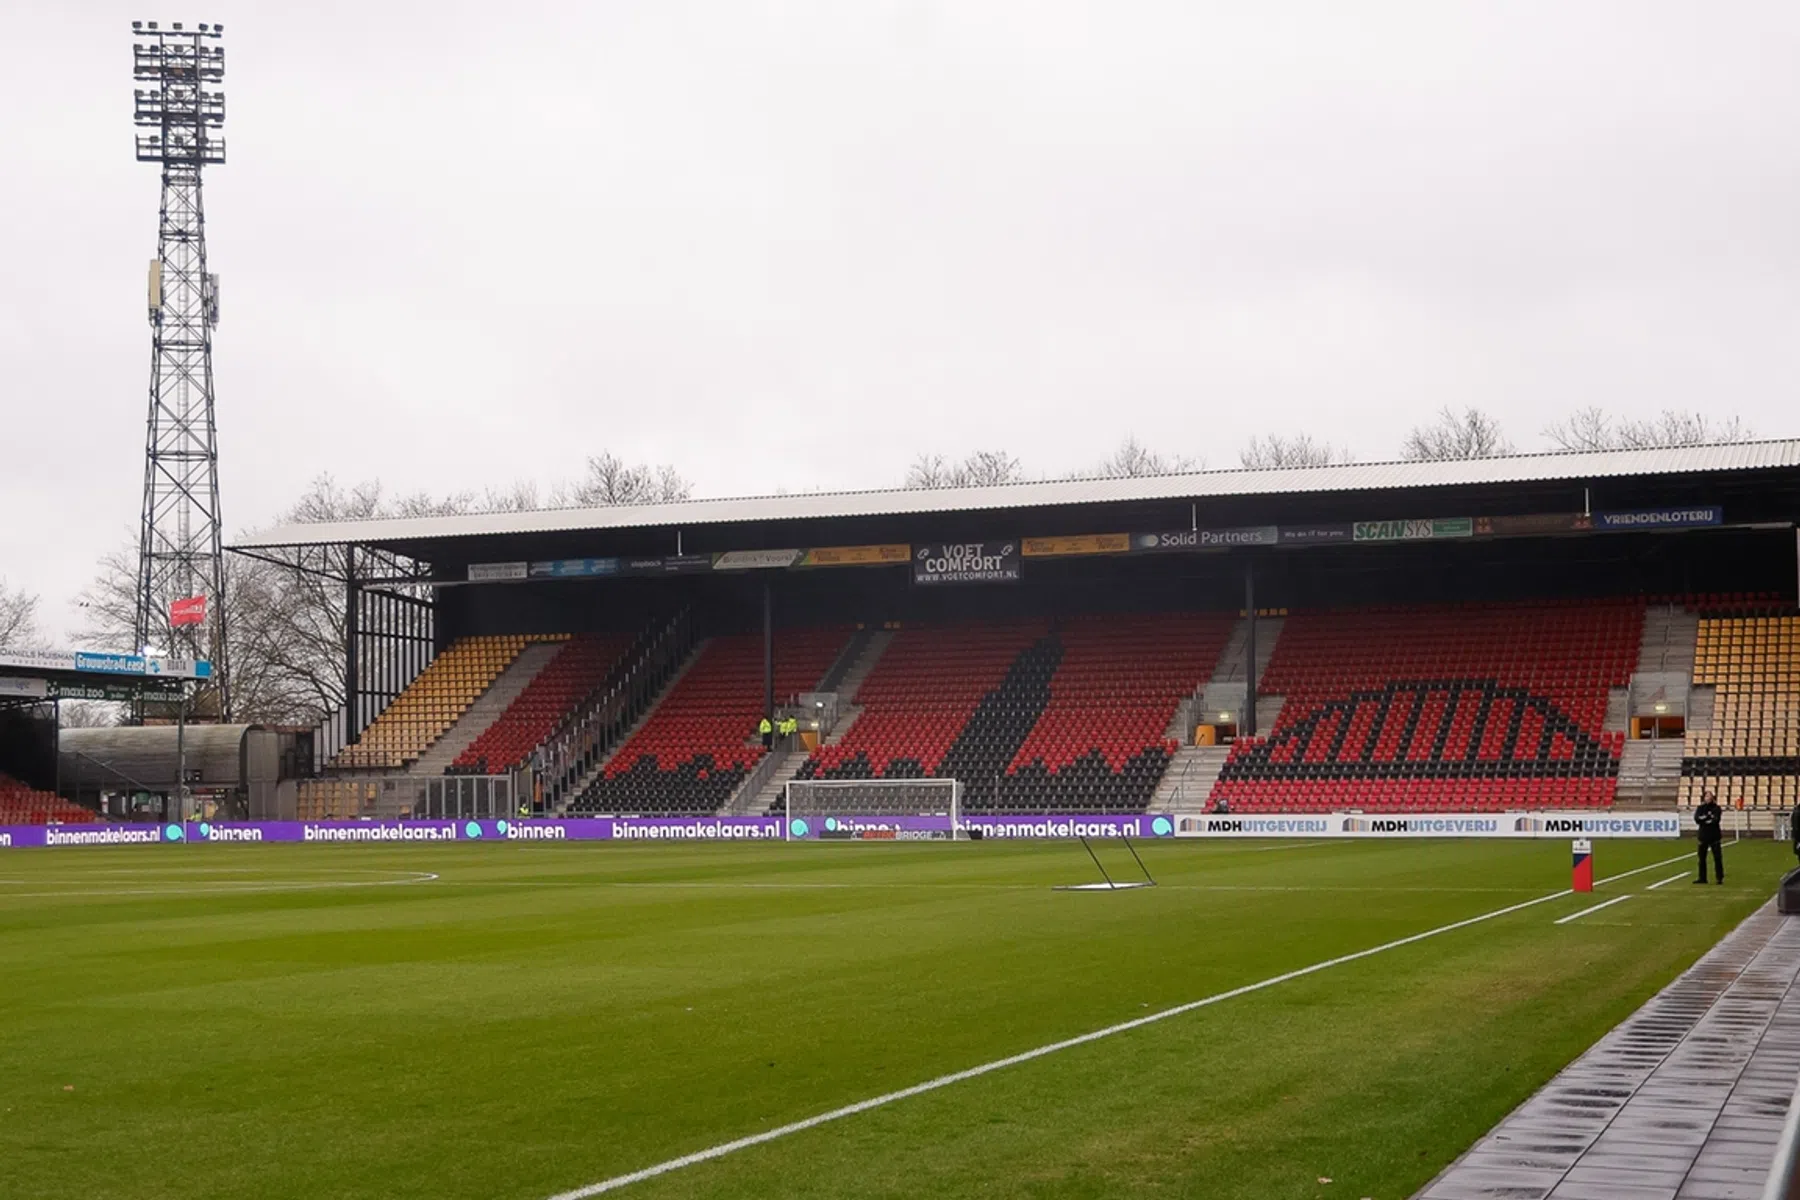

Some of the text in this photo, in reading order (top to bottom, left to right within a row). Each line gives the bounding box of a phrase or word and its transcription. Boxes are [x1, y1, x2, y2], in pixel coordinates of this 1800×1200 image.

[1603, 509, 1714, 525] VRIENDENLOTERIJ
[1355, 519, 1431, 538] SCANSYS
[1161, 529, 1263, 546] Solid Partners
[942, 543, 984, 558] VOET
[926, 556, 1003, 573] COMFORT
[915, 569, 1018, 582] WWW.VOETCOMFORT.NL
[60, 684, 86, 696] maxi
[87, 689, 104, 698] zoo
[143, 688, 184, 702] maxi zoo
[209, 824, 262, 841] binnen
[304, 823, 456, 840] binnenmakelaars.nl
[507, 822, 565, 839] binnen
[612, 820, 780, 838] binnenmakelaars.nl
[955, 818, 1140, 837] binnenmakelaars.nl
[1208, 820, 1328, 832] MDHUITGEVERIJ
[1371, 820, 1497, 832] MDHUITGEVERIJ
[1545, 820, 1677, 832] MDHUITGEVERIJ
[46, 825, 161, 845] binnenmakelaars.nl
